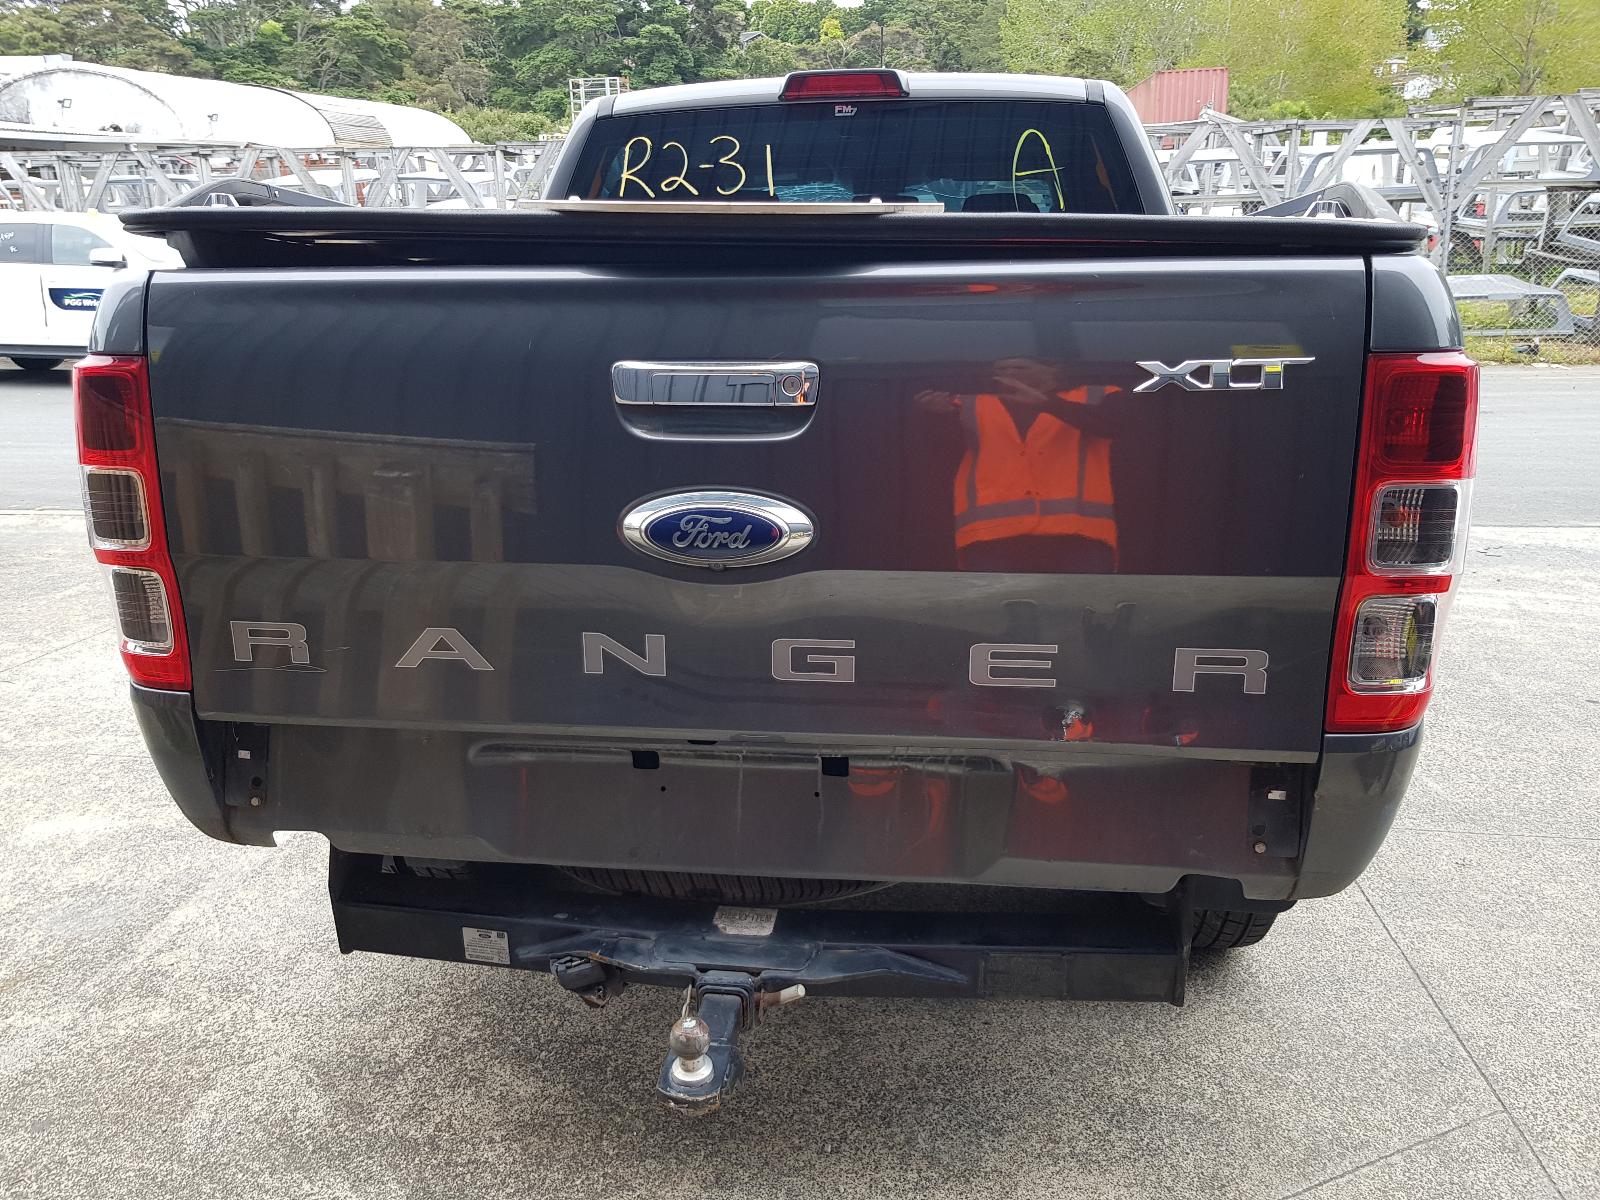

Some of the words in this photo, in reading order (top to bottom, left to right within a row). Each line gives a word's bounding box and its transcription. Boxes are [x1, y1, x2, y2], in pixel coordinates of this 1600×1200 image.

[620, 135, 775, 198] R2-31
[1012, 128, 1065, 212] A
[1132, 356, 1316, 393] XLT
[672, 514, 752, 549] Ford
[229, 619, 1270, 695] RANGER
